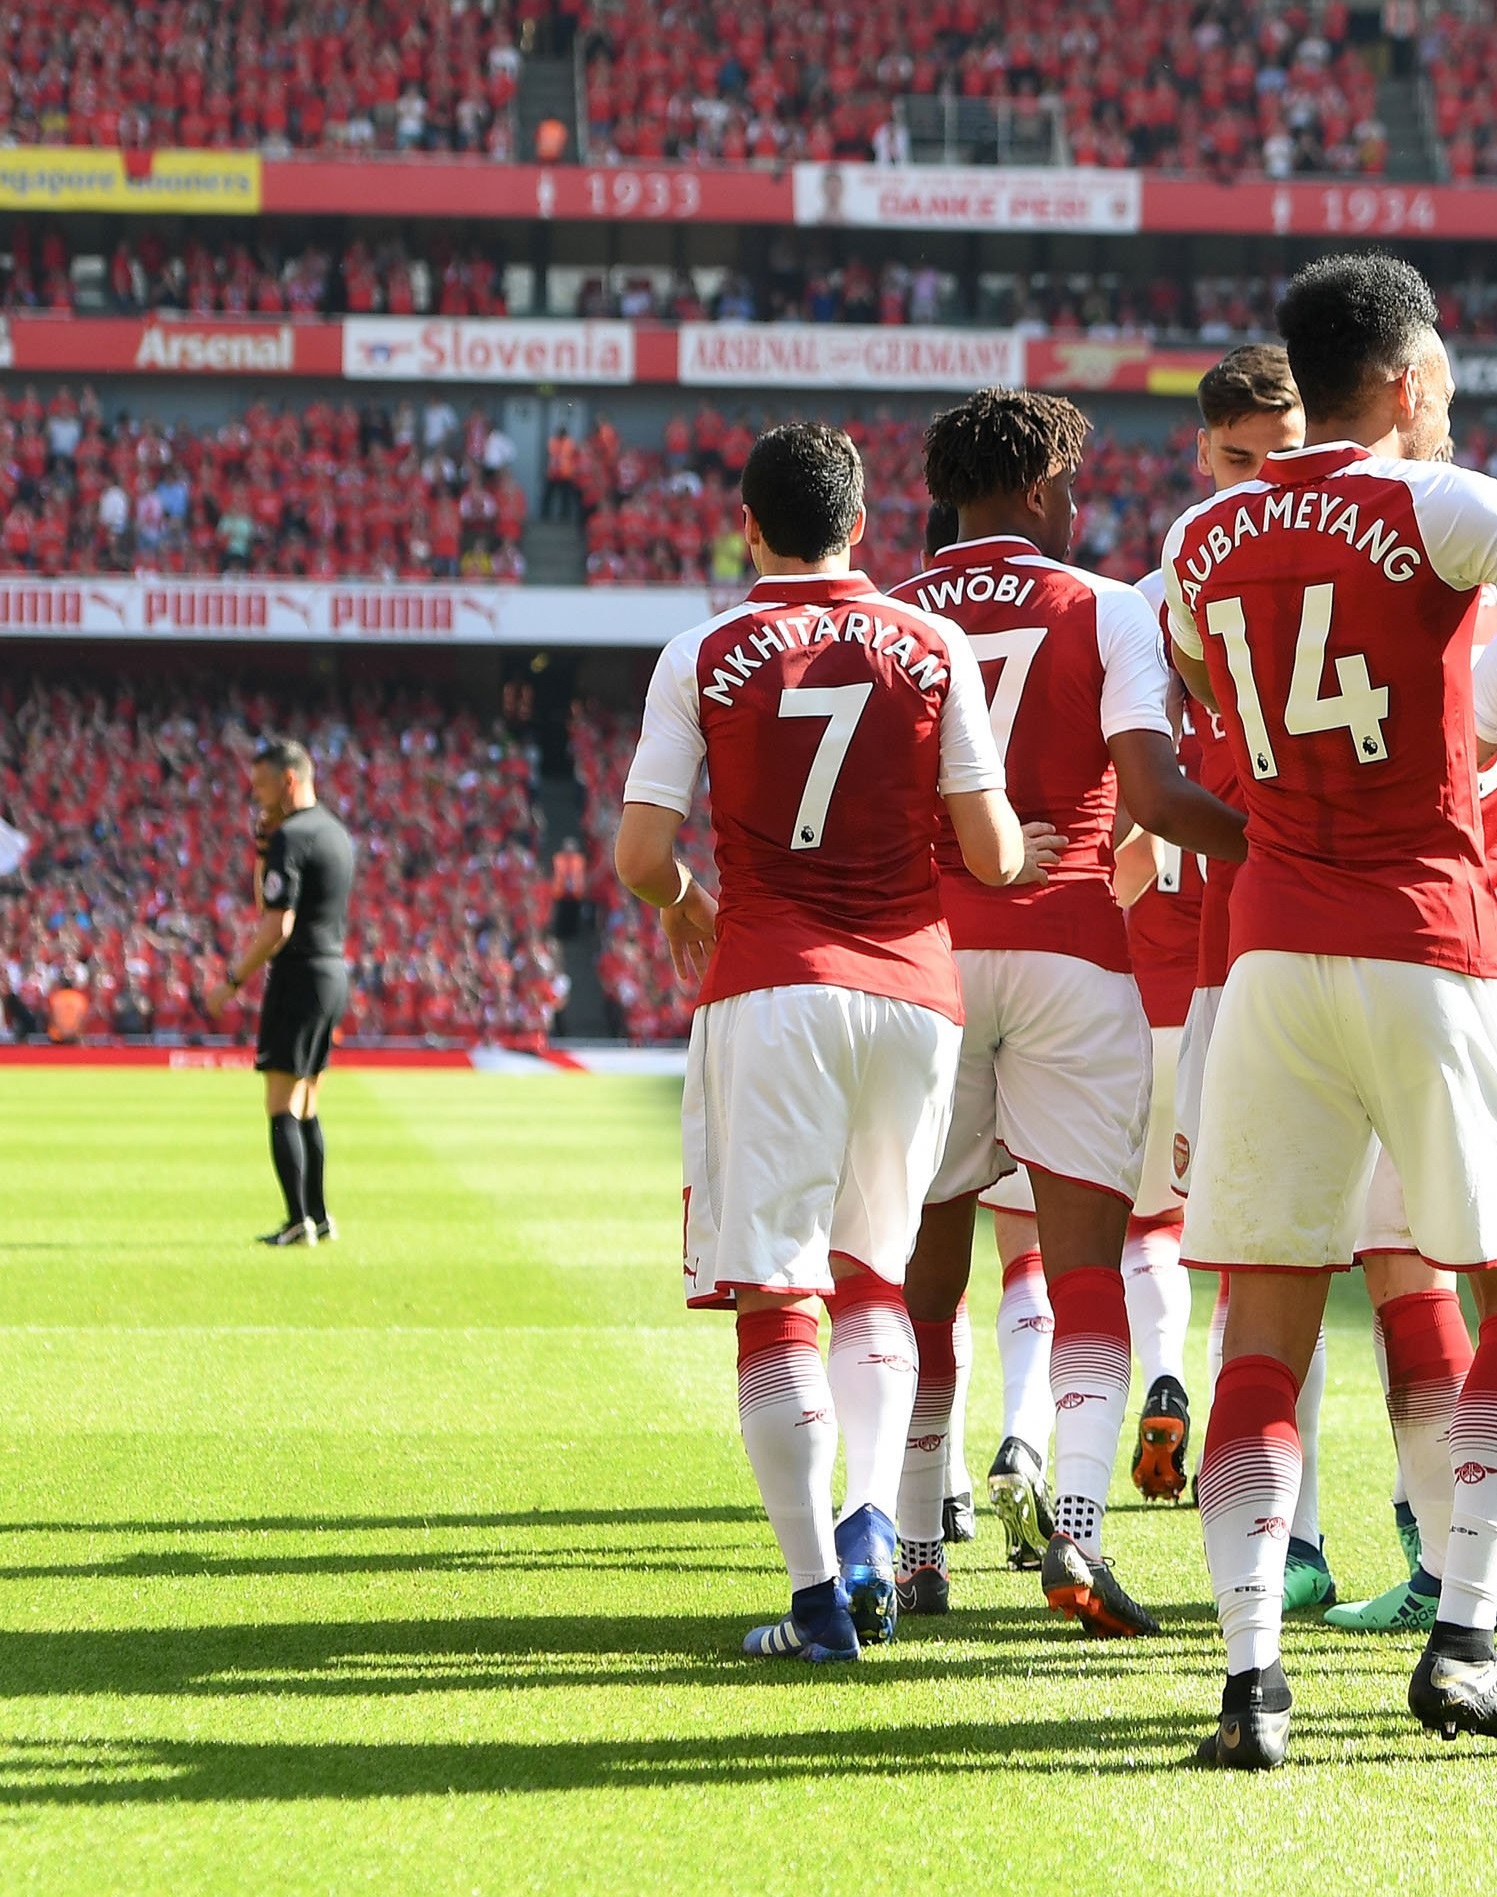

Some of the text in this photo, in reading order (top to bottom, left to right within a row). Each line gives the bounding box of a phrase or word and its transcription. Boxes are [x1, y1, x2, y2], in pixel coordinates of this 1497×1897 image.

[586, 171, 700, 217] 1933
[1321, 188, 1436, 233] 1934
[136, 324, 294, 371] Arsenal
[420, 321, 621, 373] Slovenia
[694, 334, 1010, 375] ARSENAL GERMANY
[1182, 492, 1421, 611] AUBAMEYANG
[145, 591, 267, 628] PUMA
[331, 595, 454, 630] PUMA
[916, 574, 1035, 612] IWOBI
[702, 612, 949, 707] MKHITARYAN
[1206, 583, 1389, 781] 14
[778, 682, 873, 850] 7
